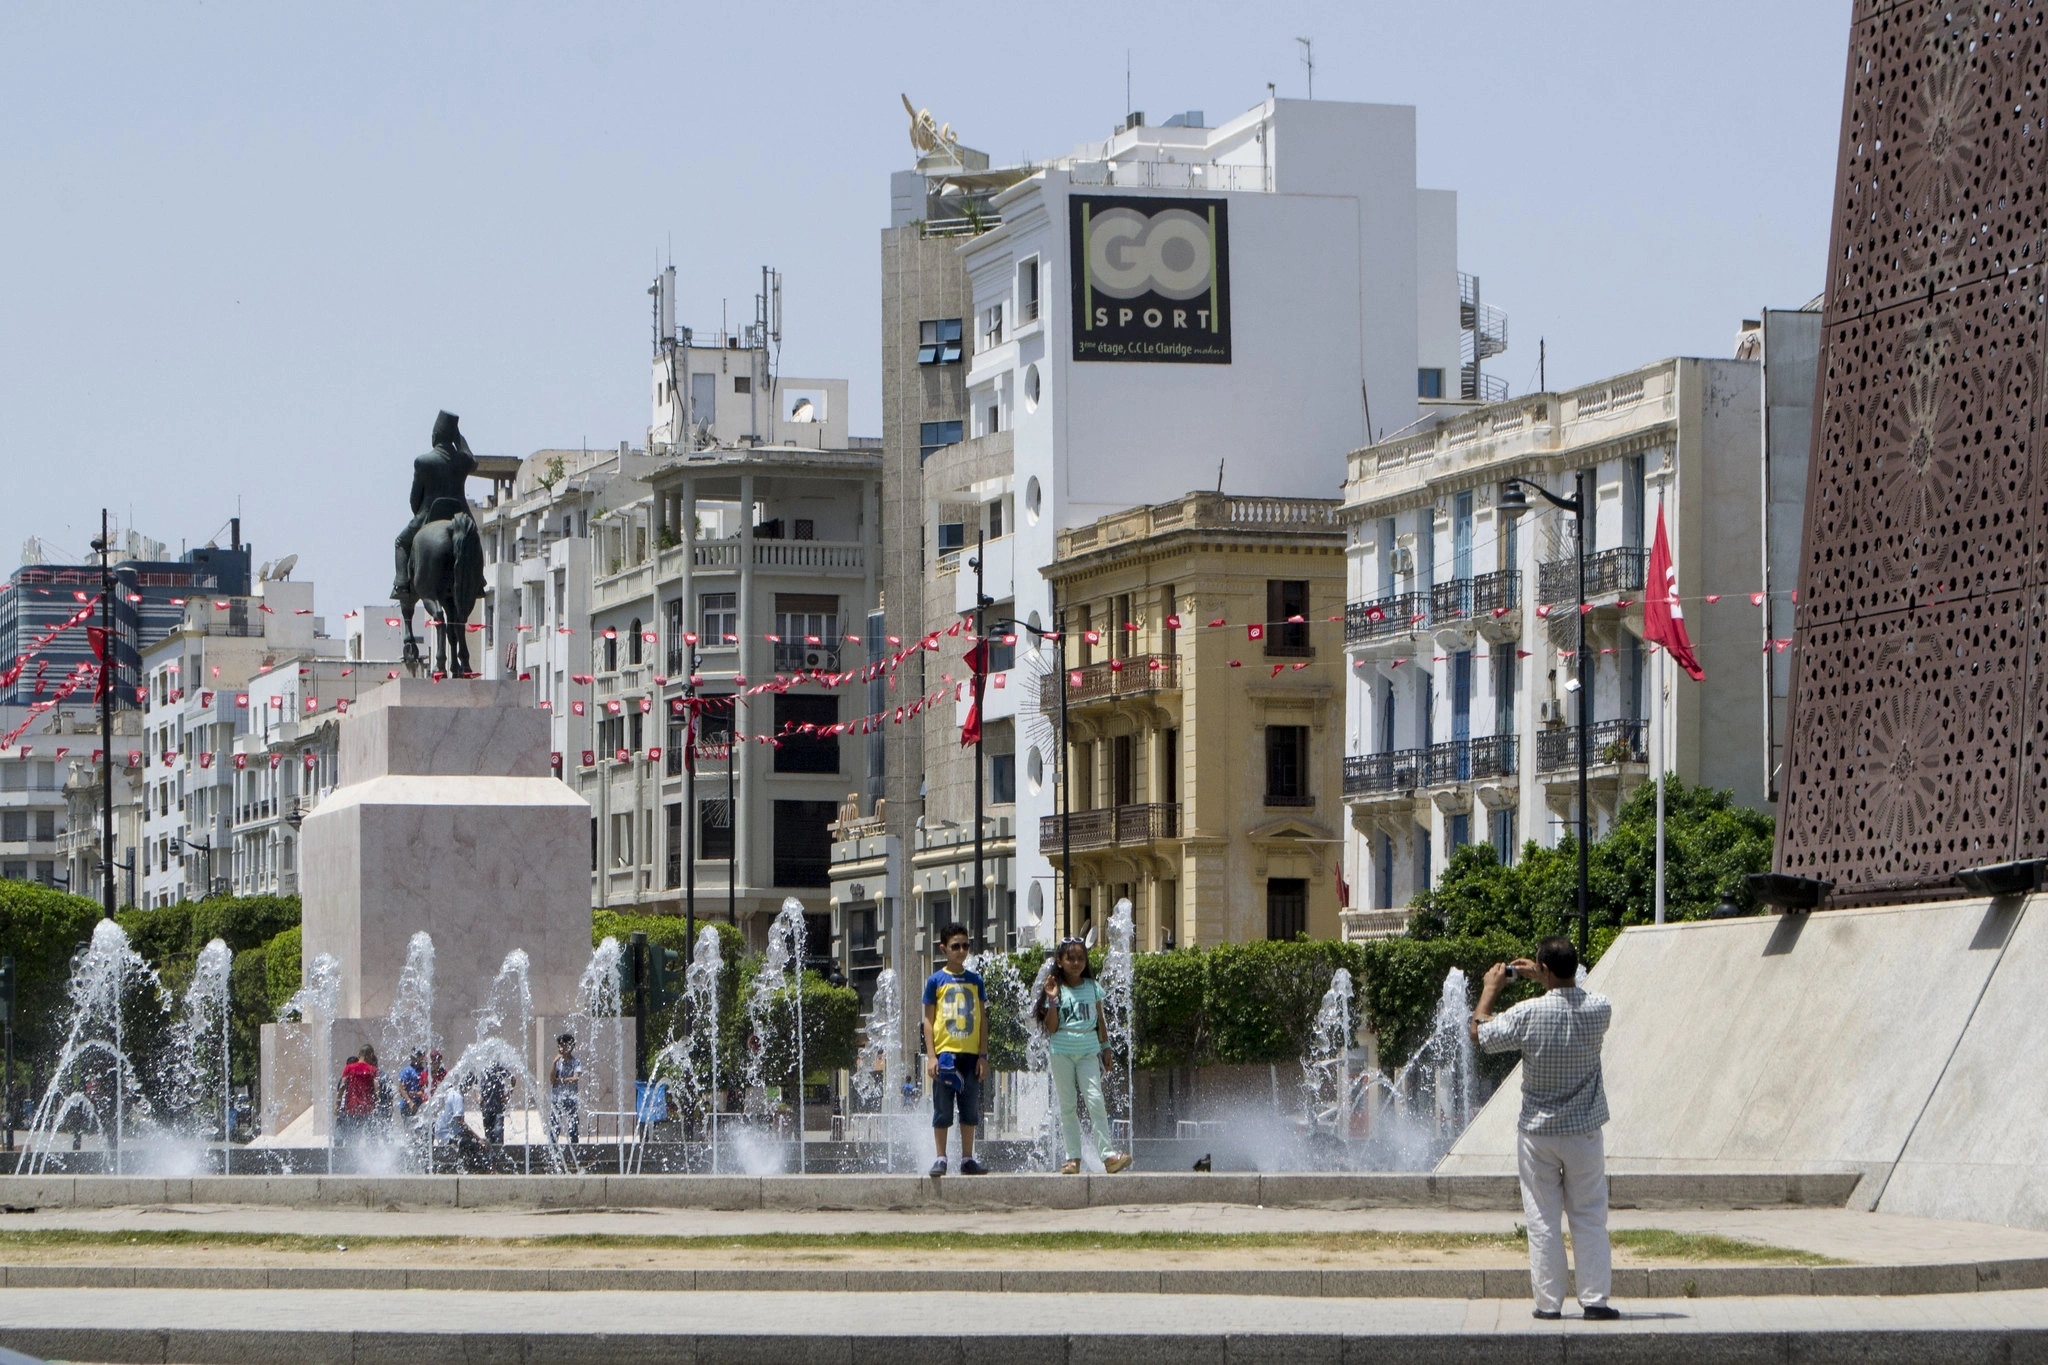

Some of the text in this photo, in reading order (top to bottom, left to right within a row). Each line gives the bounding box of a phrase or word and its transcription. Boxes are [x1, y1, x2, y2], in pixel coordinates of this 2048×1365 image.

[1089, 209, 1211, 298] GO
[1095, 307, 1210, 329] SPORT
[1098, 341, 1127, 356] étage,
[1128, 342, 1142, 353] C.C
[1144, 342, 1154, 354] Le
[1155, 342, 1192, 357] Claridge
[944, 984, 975, 1037] 3
